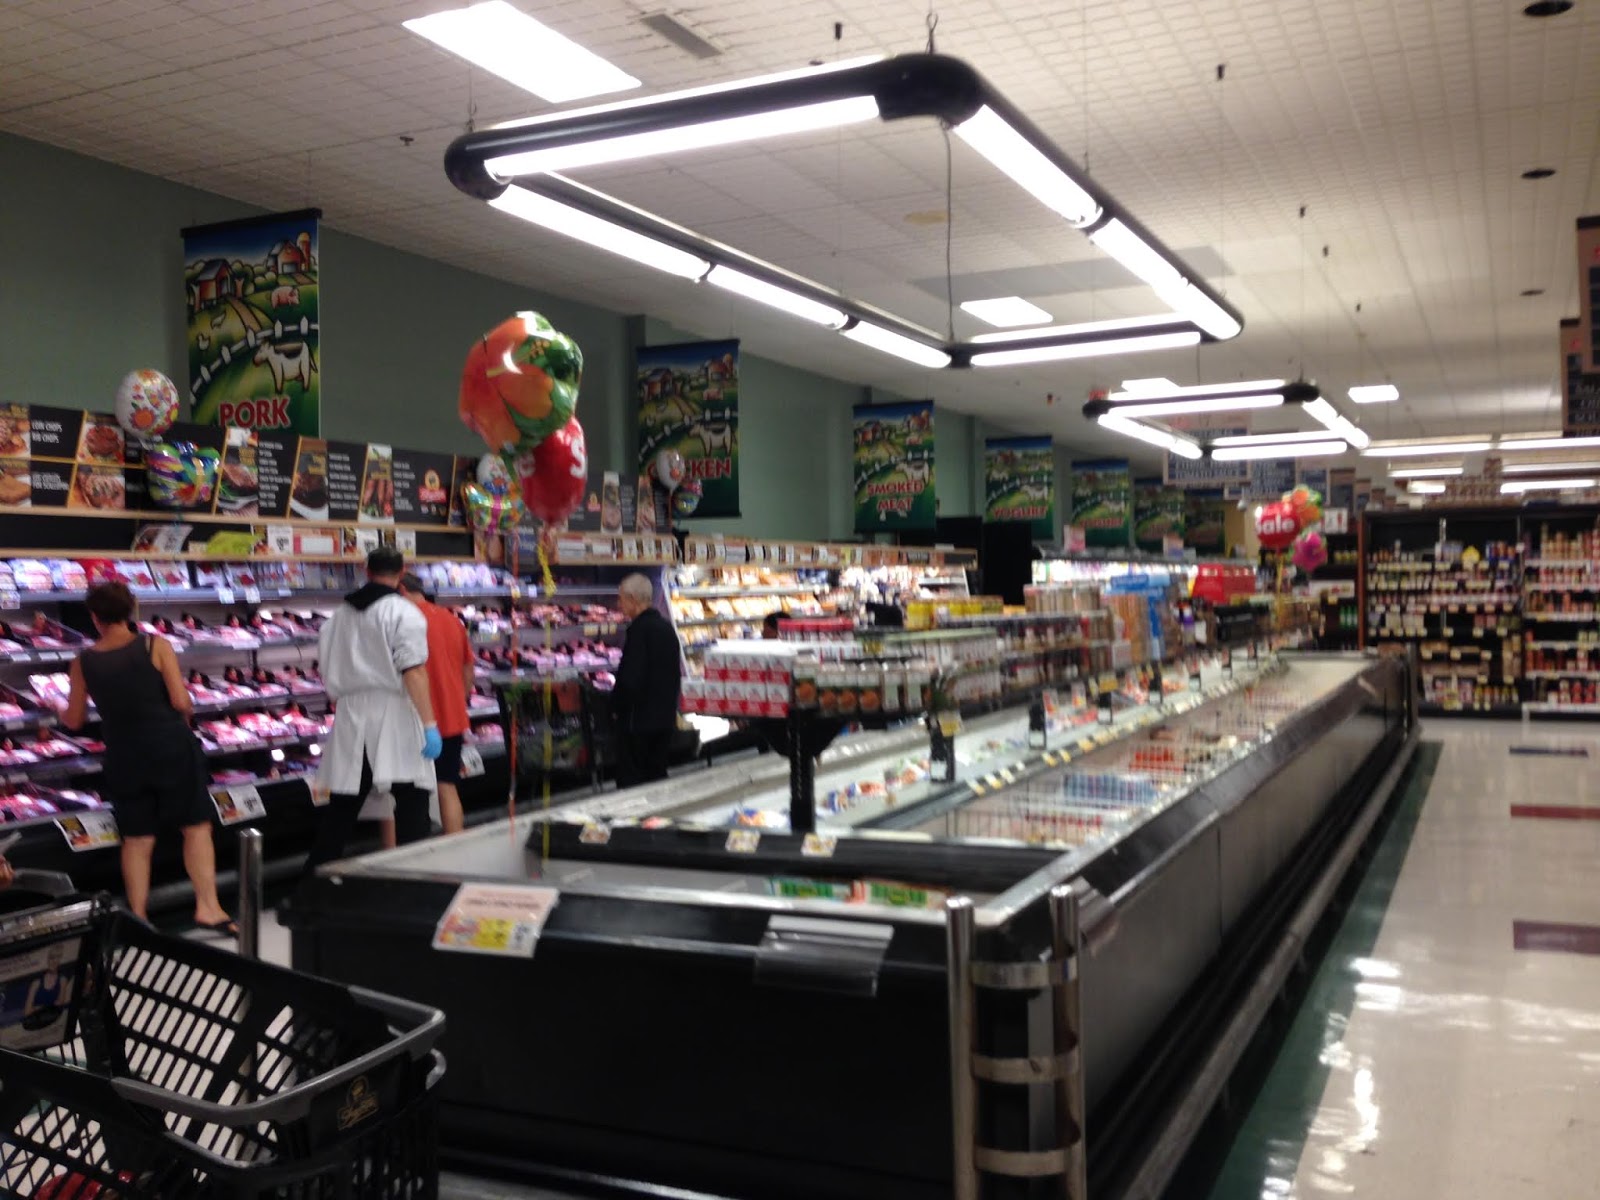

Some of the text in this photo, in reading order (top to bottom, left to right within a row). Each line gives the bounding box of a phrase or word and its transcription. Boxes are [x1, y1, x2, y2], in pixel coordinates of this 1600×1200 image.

[218, 395, 291, 428] PORK
[45, 422, 63, 433] CHOPS
[42, 433, 60, 444] CHOPS
[867, 480, 925, 496] SMOKED
[877, 497, 914, 512] MEAT
